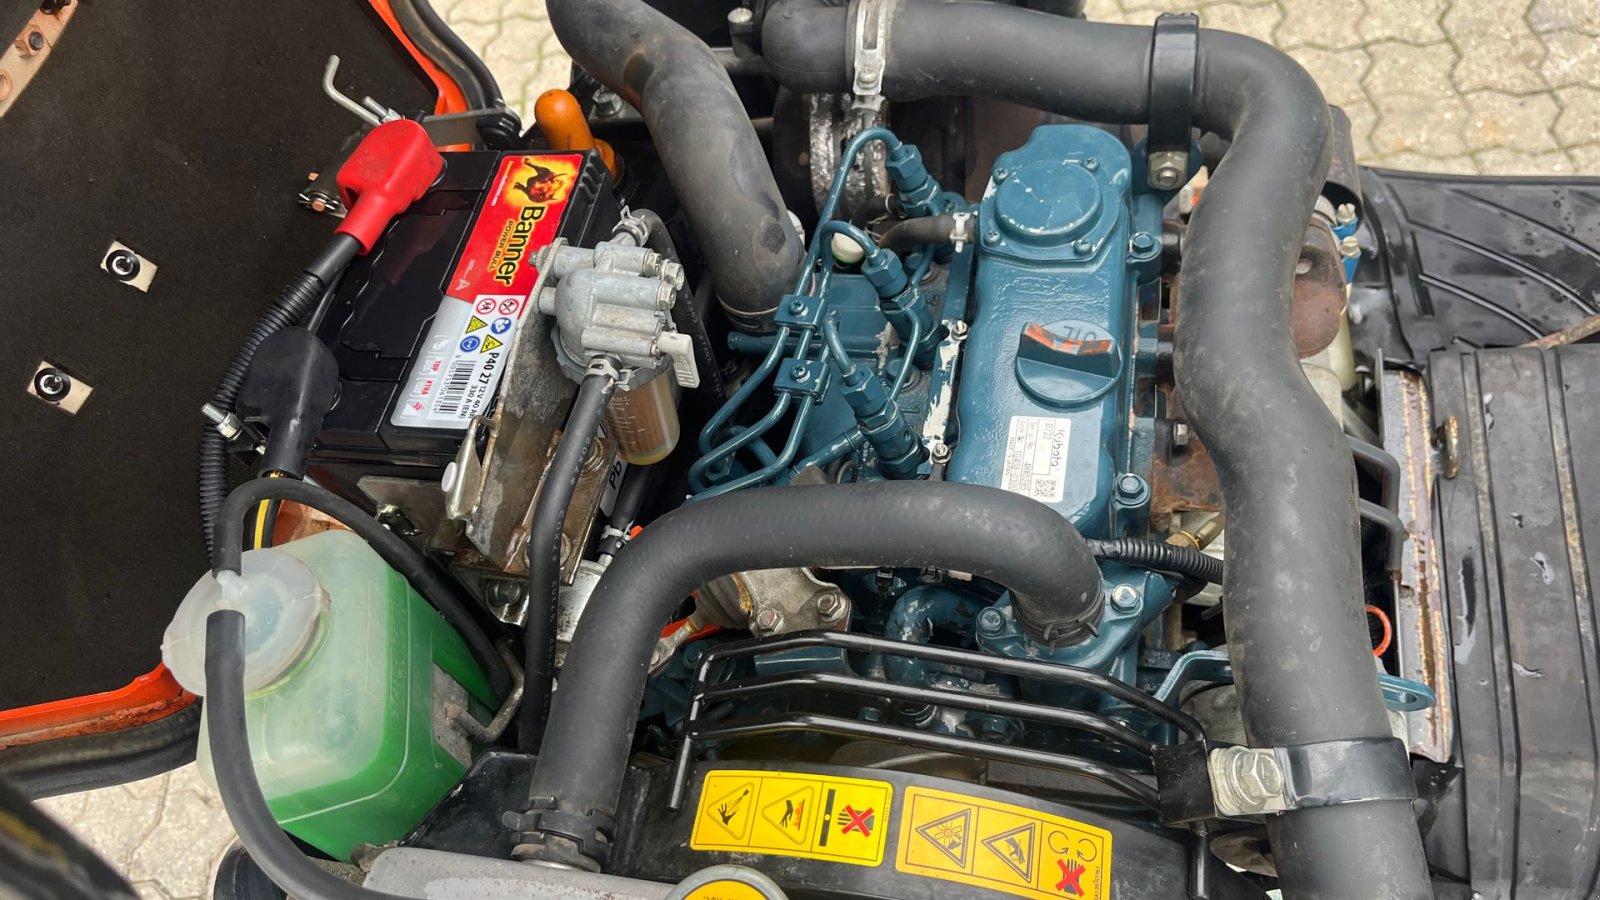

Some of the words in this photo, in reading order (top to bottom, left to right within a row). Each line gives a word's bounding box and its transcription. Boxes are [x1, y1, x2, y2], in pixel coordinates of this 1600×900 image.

[499, 220, 514, 249] POWER
[496, 206, 546, 285] Banner
[489, 249, 502, 270] BULL
[431, 360, 441, 371] TOP
[483, 353, 500, 371] P40
[478, 372, 492, 384] 27
[467, 385, 478, 398] 330
[459, 405, 470, 419] (EN)
[472, 399, 481, 409] 40
[1043, 423, 1054, 440] D722
[1051, 429, 1065, 467] Kubota
[609, 461, 622, 490] Pb
